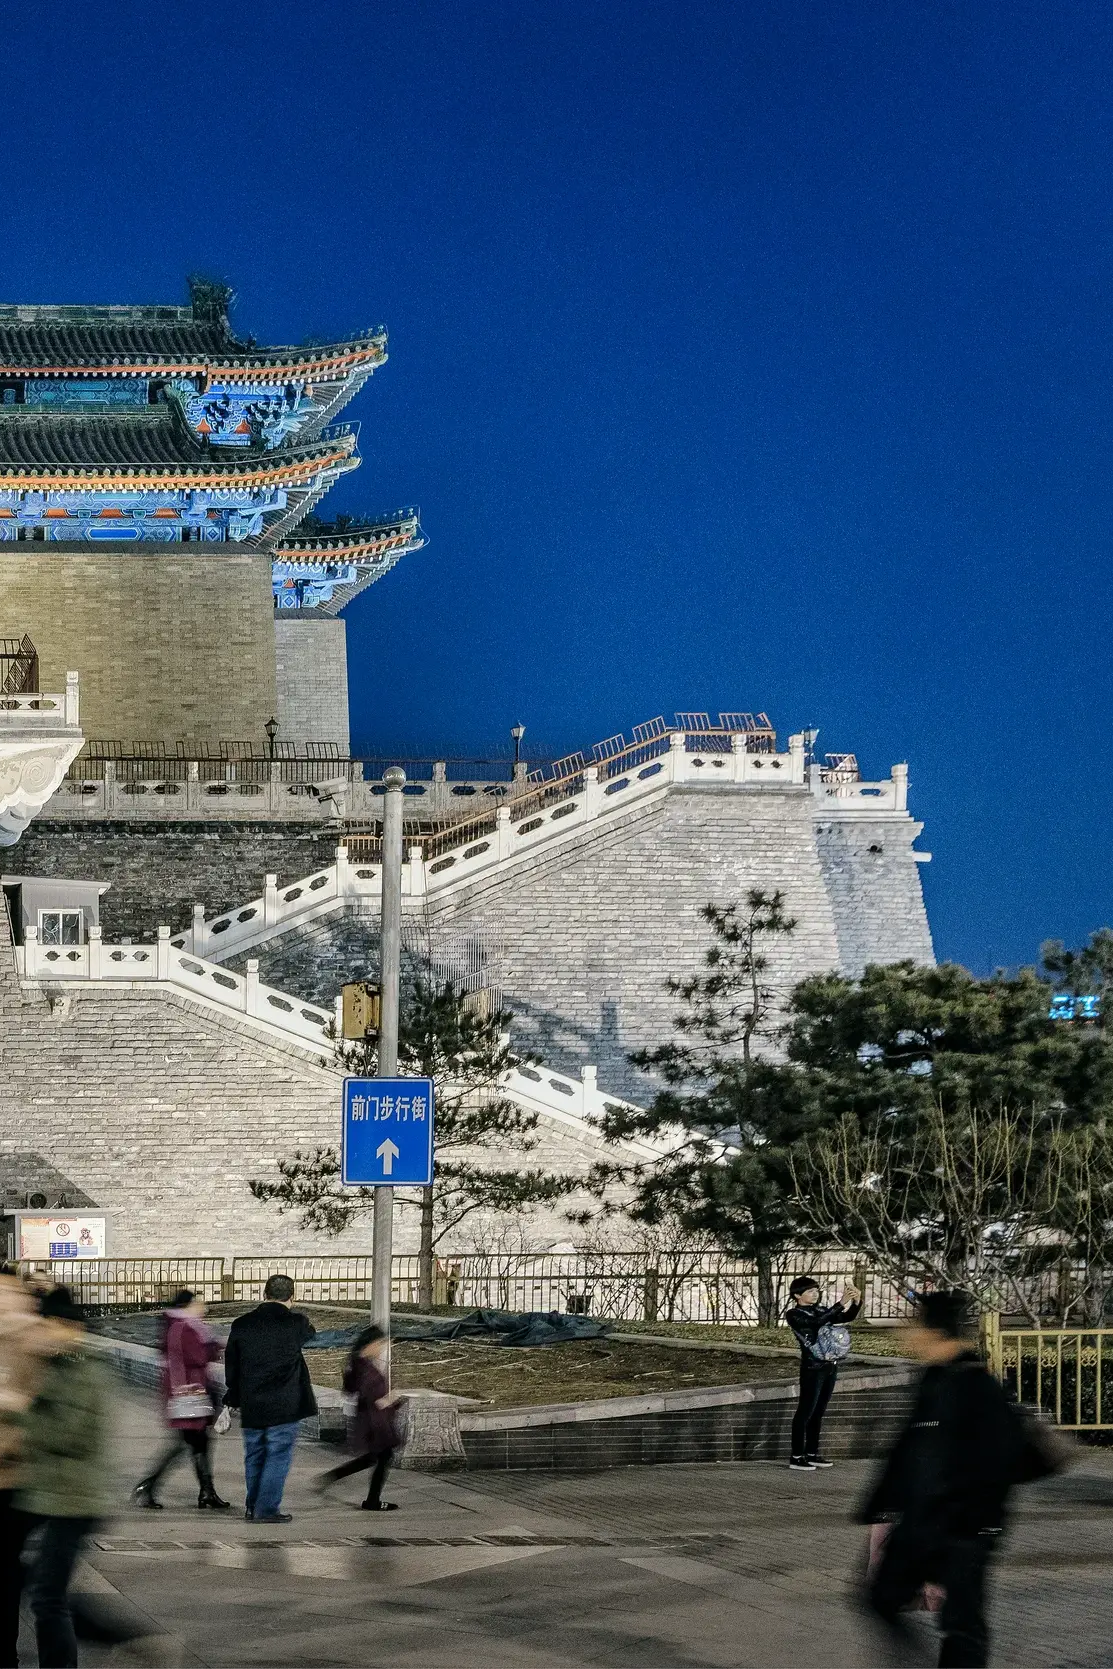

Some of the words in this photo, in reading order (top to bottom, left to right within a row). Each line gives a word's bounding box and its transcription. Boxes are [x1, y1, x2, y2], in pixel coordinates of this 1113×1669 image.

[351, 1094, 427, 1122] 前门步行街
